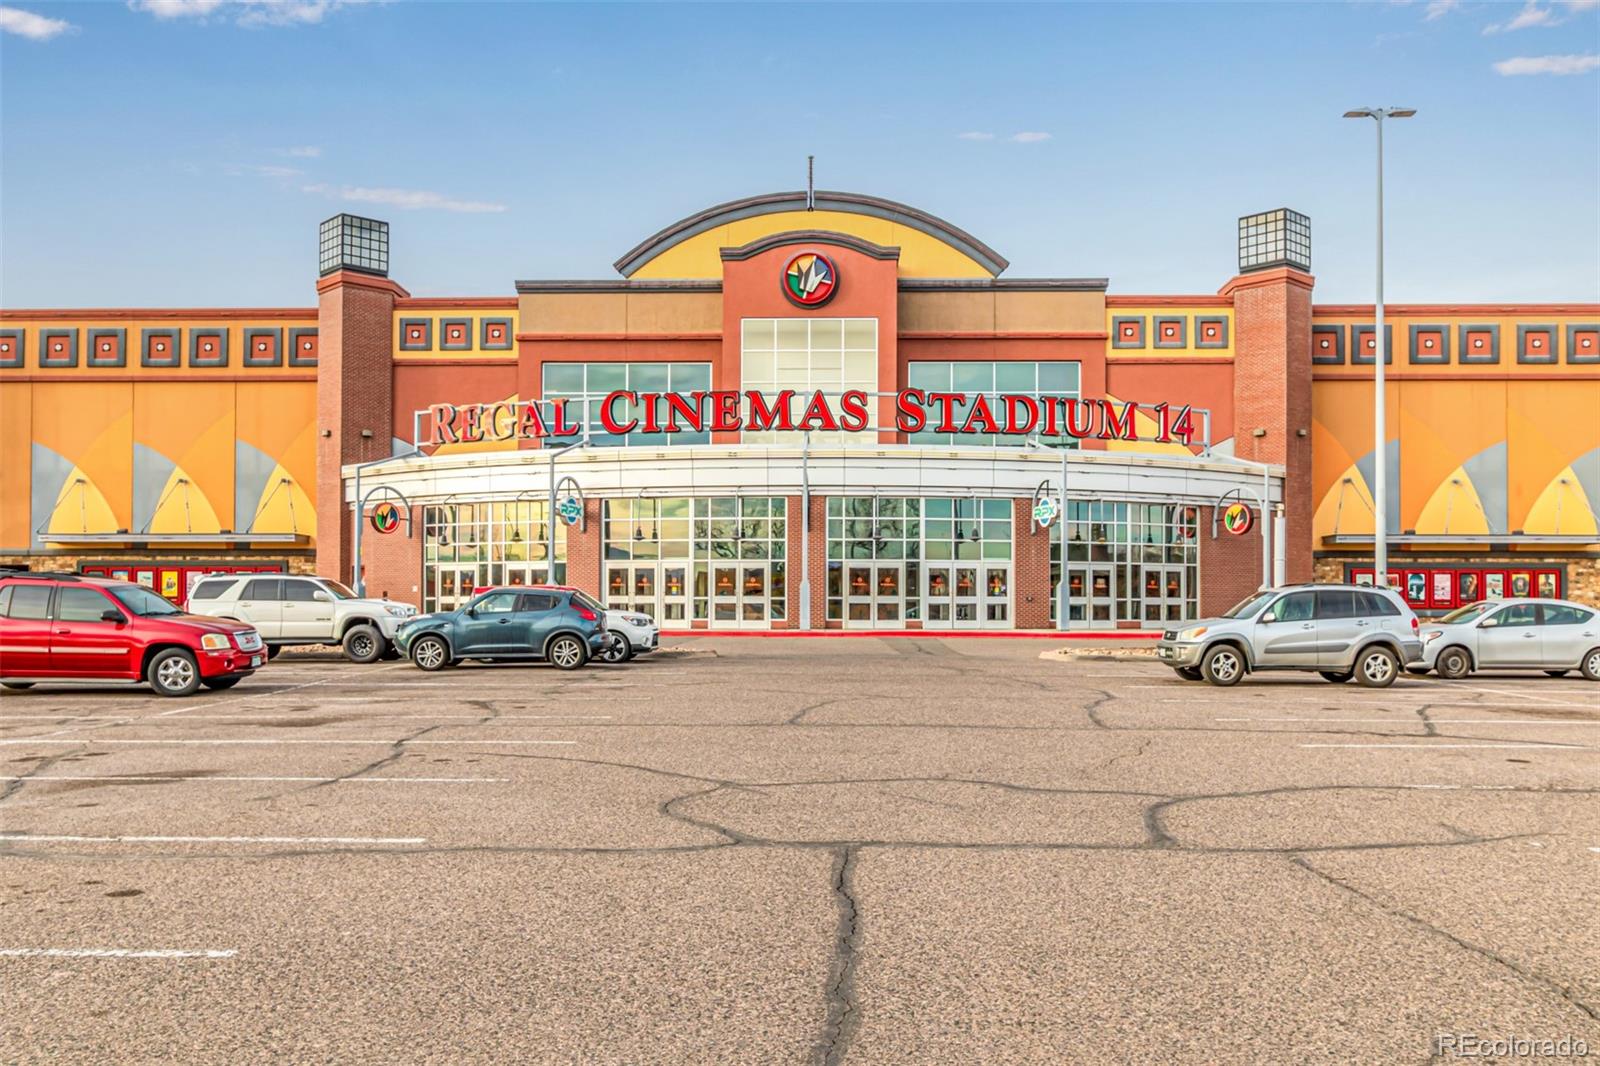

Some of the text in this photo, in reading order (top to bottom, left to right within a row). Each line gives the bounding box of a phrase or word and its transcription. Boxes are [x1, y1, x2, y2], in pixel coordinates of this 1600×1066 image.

[429, 388, 1195, 446] REGAL CINEMAS STADIUM 14
[561, 503, 581, 516] RPX
